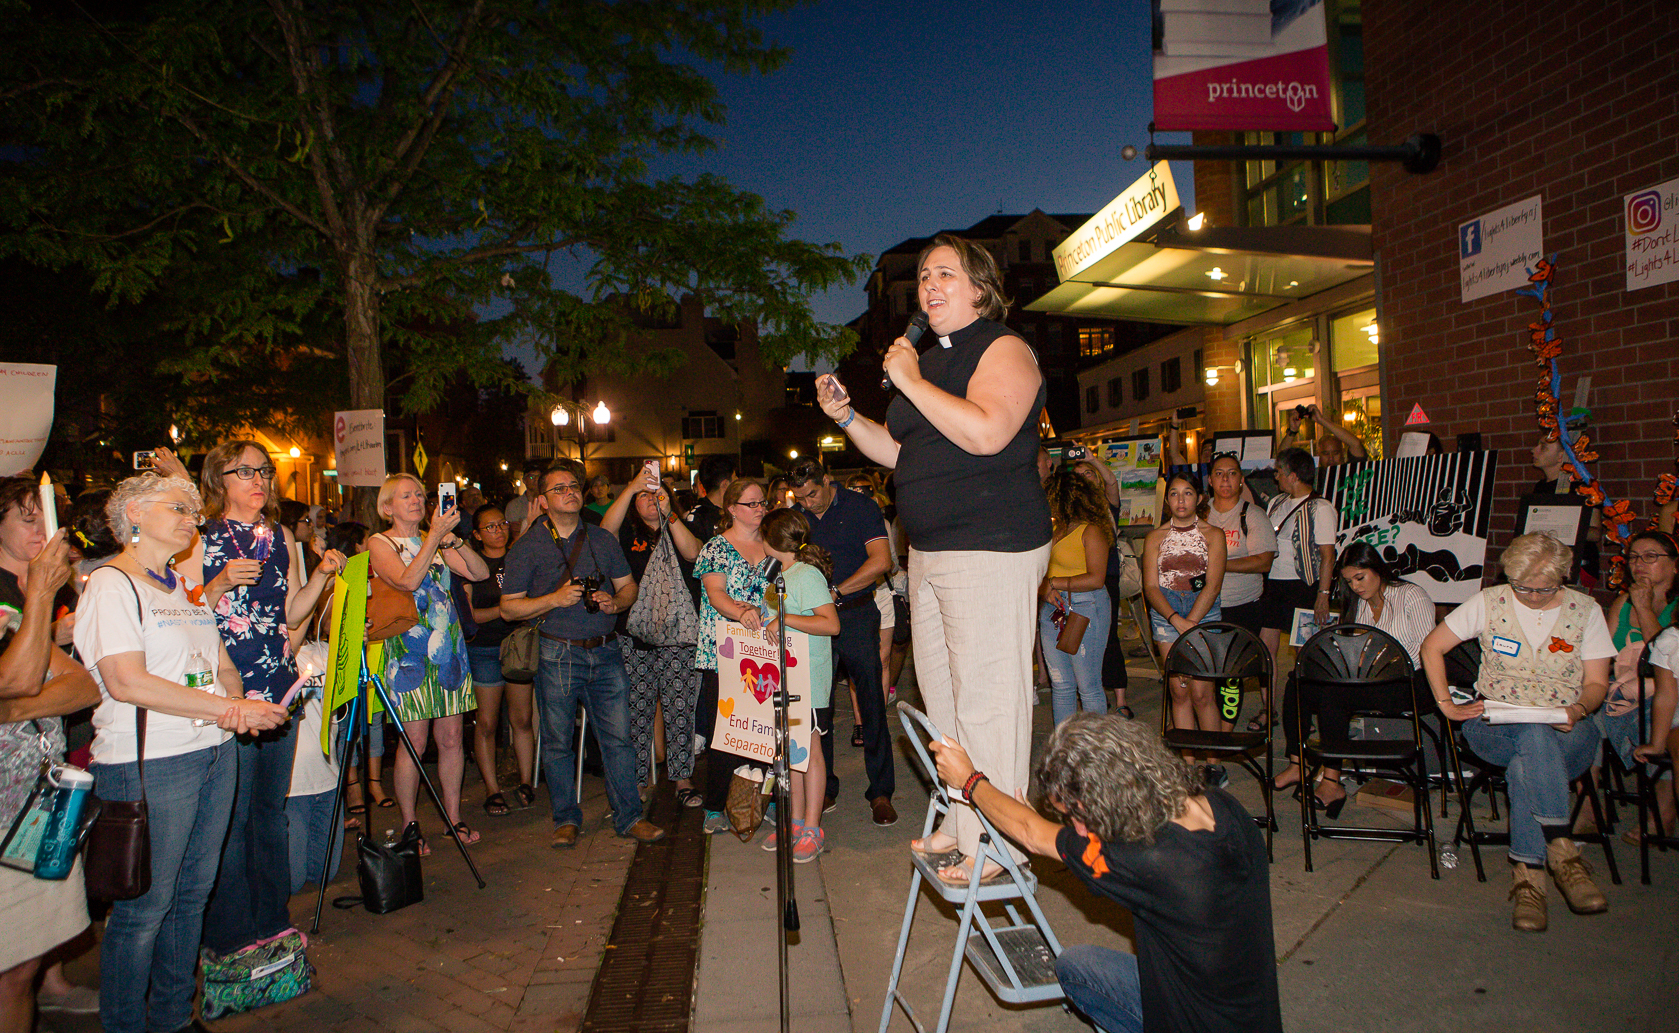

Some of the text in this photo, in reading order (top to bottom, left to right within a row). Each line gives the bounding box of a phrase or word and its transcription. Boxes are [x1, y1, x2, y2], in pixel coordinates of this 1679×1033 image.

[1207, 78, 1318, 112] princeton
[1057, 181, 1167, 276] Princeton Public Library
[1337, 468, 1374, 492] LAND
[1346, 484, 1365, 504] OF
[1340, 498, 1369, 520] THE
[151, 608, 181, 617] PROUD
[181, 608, 192, 617] TO
[192, 608, 202, 616] BE
[157, 618, 216, 628] #NASTY WOMAN
[726, 624, 761, 640] Families
[739, 641, 780, 660] Together!
[729, 714, 774, 737] End Fam
[723, 732, 774, 758] Separatio
